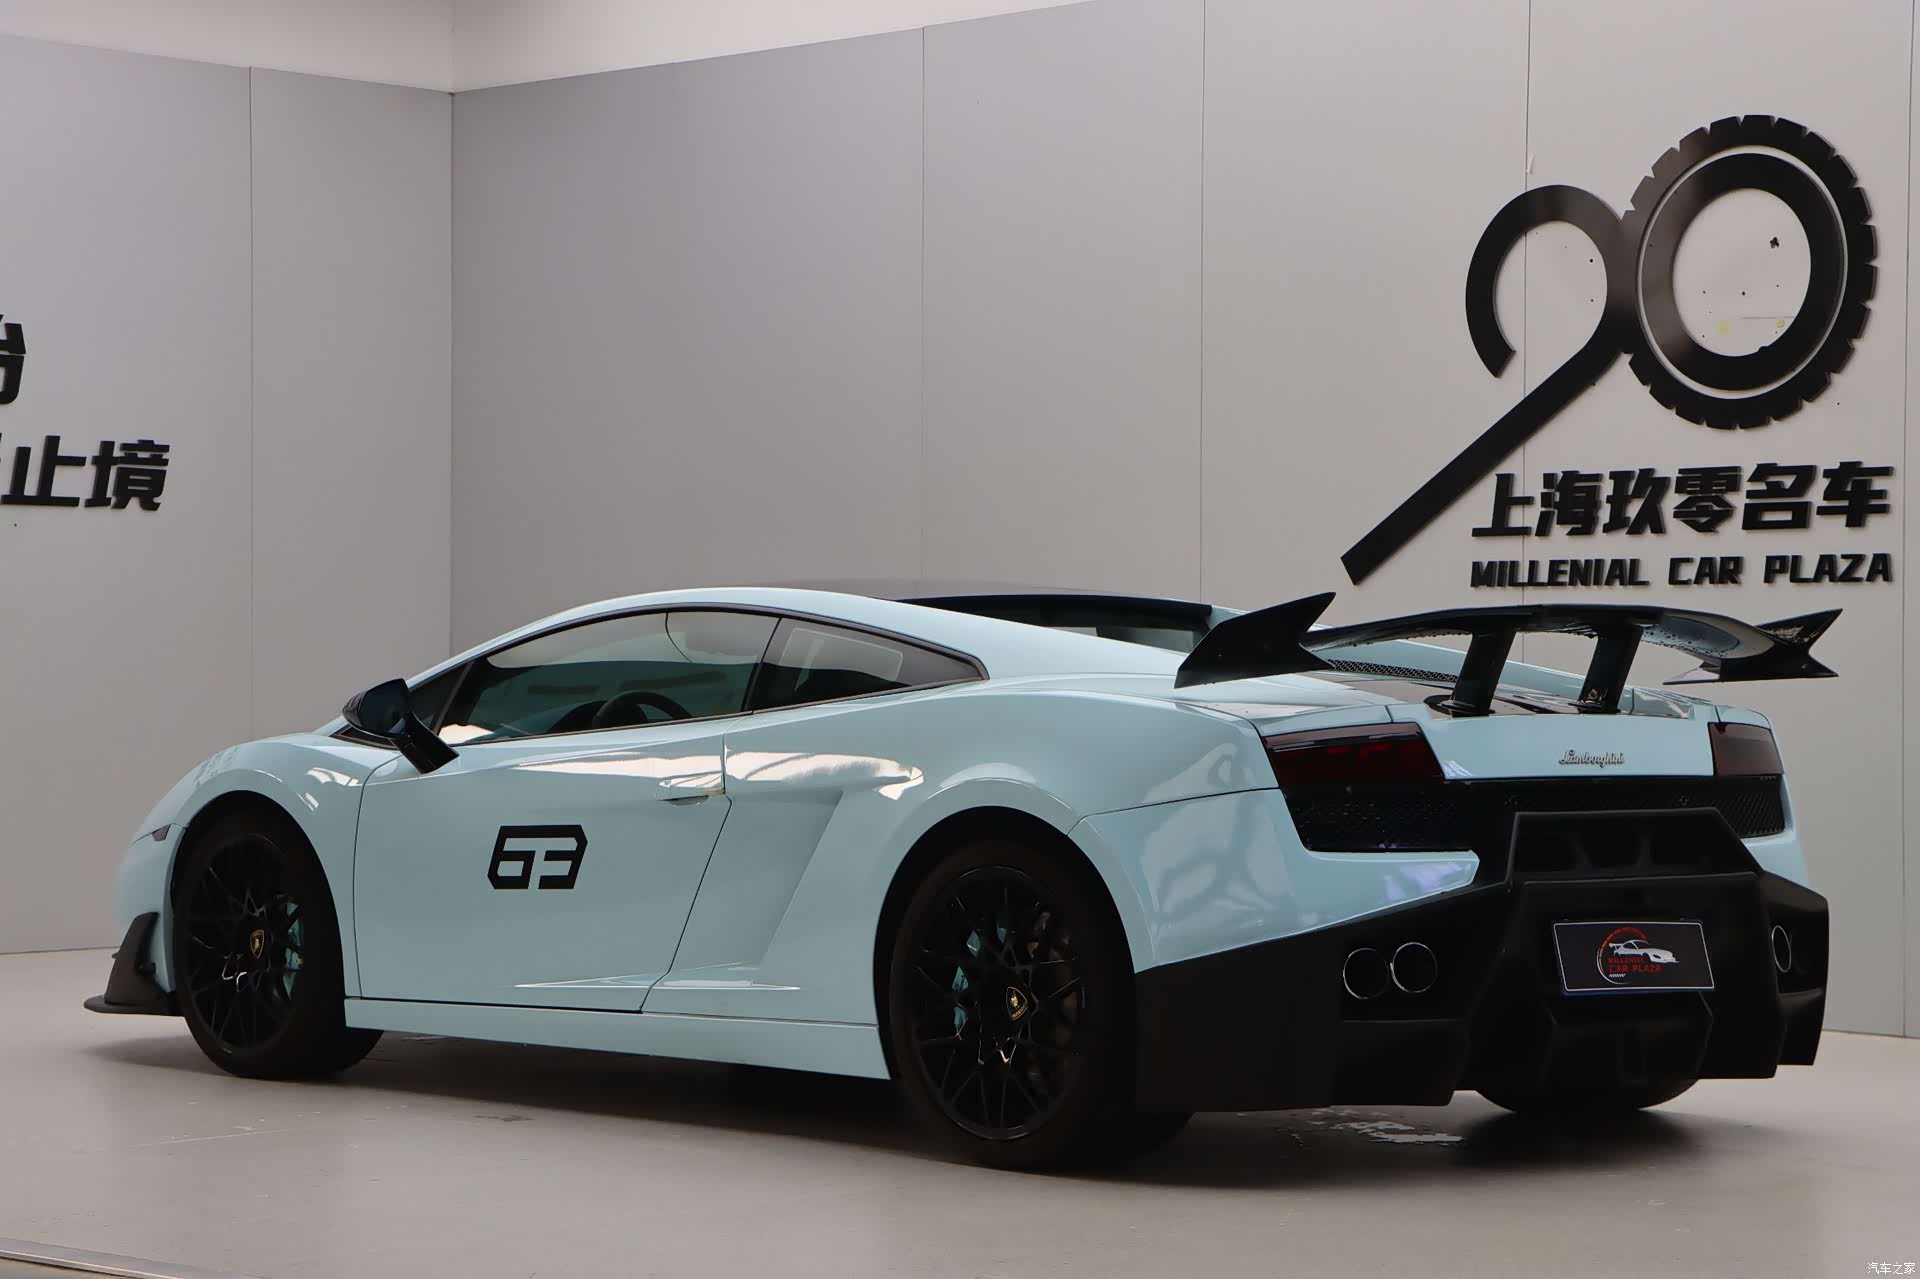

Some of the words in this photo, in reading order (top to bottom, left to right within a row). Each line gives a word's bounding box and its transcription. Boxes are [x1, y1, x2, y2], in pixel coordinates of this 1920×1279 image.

[0, 433, 171, 511] 止境
[1471, 461, 1894, 537] 上海玖零名车
[1470, 557, 1650, 588] MILLENIAL
[1668, 556, 1743, 586] CAR
[1763, 553, 1893, 583] PLAZA
[487, 824, 588, 890] 63
